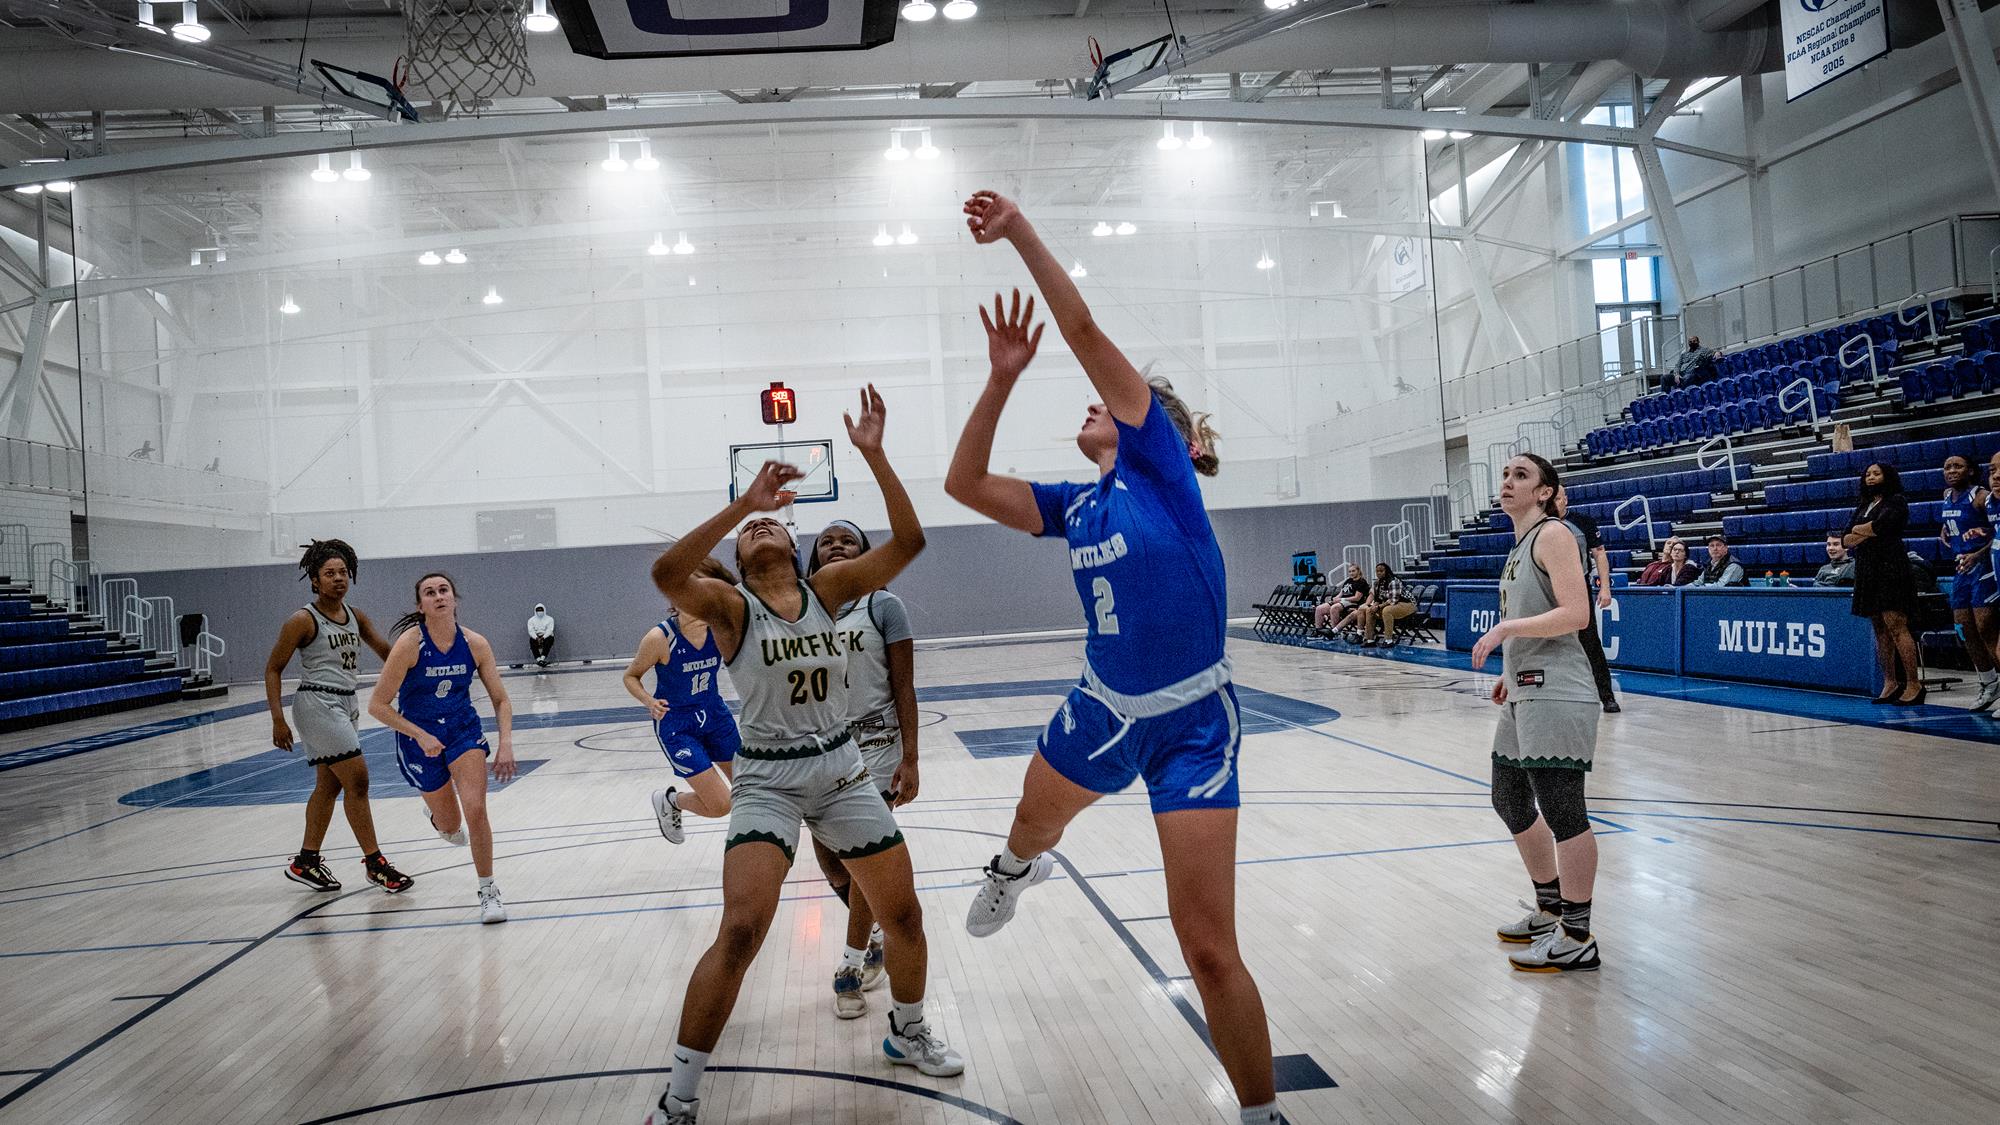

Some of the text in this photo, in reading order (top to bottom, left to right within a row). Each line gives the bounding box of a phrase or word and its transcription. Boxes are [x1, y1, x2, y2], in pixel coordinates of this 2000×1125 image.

[1786, 6, 1881, 63] NCAA Regional Champions
[1796, 1, 1866, 44] NESCAC Champions
[1810, 33, 1856, 64] NCAA Elite 8
[1823, 56, 1845, 75] 2005
[774, 400, 792, 420] 17
[1070, 532, 1128, 571] MULES
[1092, 576, 1120, 635] 2
[761, 631, 842, 667] UMFK
[1718, 619, 1826, 658] MULES
[425, 664, 467, 677] MULES
[682, 656, 718, 673] MULES
[691, 671, 711, 695] 12
[787, 666, 829, 706] 20
